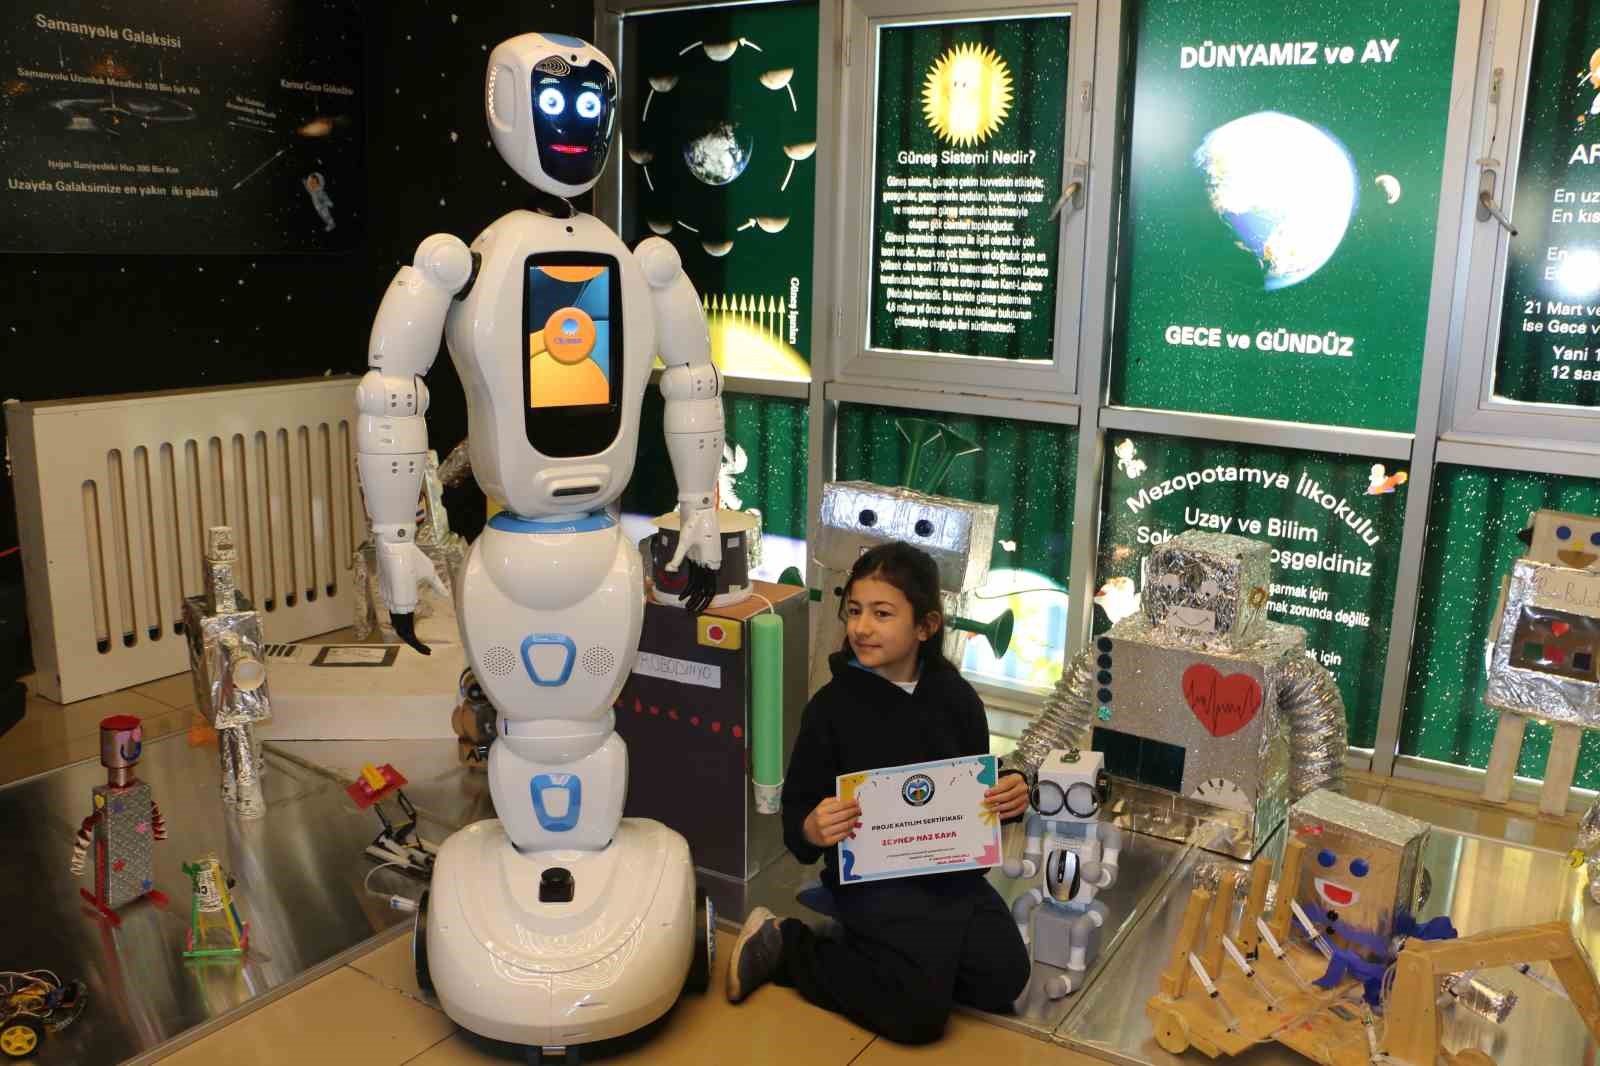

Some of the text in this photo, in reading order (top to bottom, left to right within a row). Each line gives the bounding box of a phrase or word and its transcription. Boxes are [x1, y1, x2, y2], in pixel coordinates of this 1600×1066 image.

[35, 13, 181, 49] Samanyolu Galaksisi
[1180, 37, 1400, 69] DÜNYAMIZ ve AY
[898, 150, 1036, 167] Güneş Sistemi Nedir?
[7, 177, 53, 194] Uzayda
[55, 180, 121, 195] Galaksimize
[124, 186, 137, 195] en
[186, 186, 218, 199] galaksi
[1553, 189, 1575, 203] En
[1552, 209, 1573, 223] En
[1547, 246, 1568, 261] En
[1524, 301, 1541, 314] 21
[1546, 301, 1583, 316] Mart
[1547, 320, 1587, 334] Gece
[1164, 325, 1355, 358] GECE ve GÜNDÜZ
[1552, 345, 1589, 361] Yani
[1551, 364, 1570, 380] 12
[1125, 466, 1381, 547] Mezopotamya İlkokulu
[1184, 506, 1318, 542] Uzay ve Bilim
[1137, 526, 1179, 546] Sok
[1270, 549, 1373, 577] oşgeldiniz
[1269, 583, 1329, 603] şarmak için
[1265, 600, 1371, 627] mak zorunda değiliz
[1320, 649, 1342, 667] için
[871, 823, 894, 831] PROJE
[894, 819, 922, 829] KATILIM
